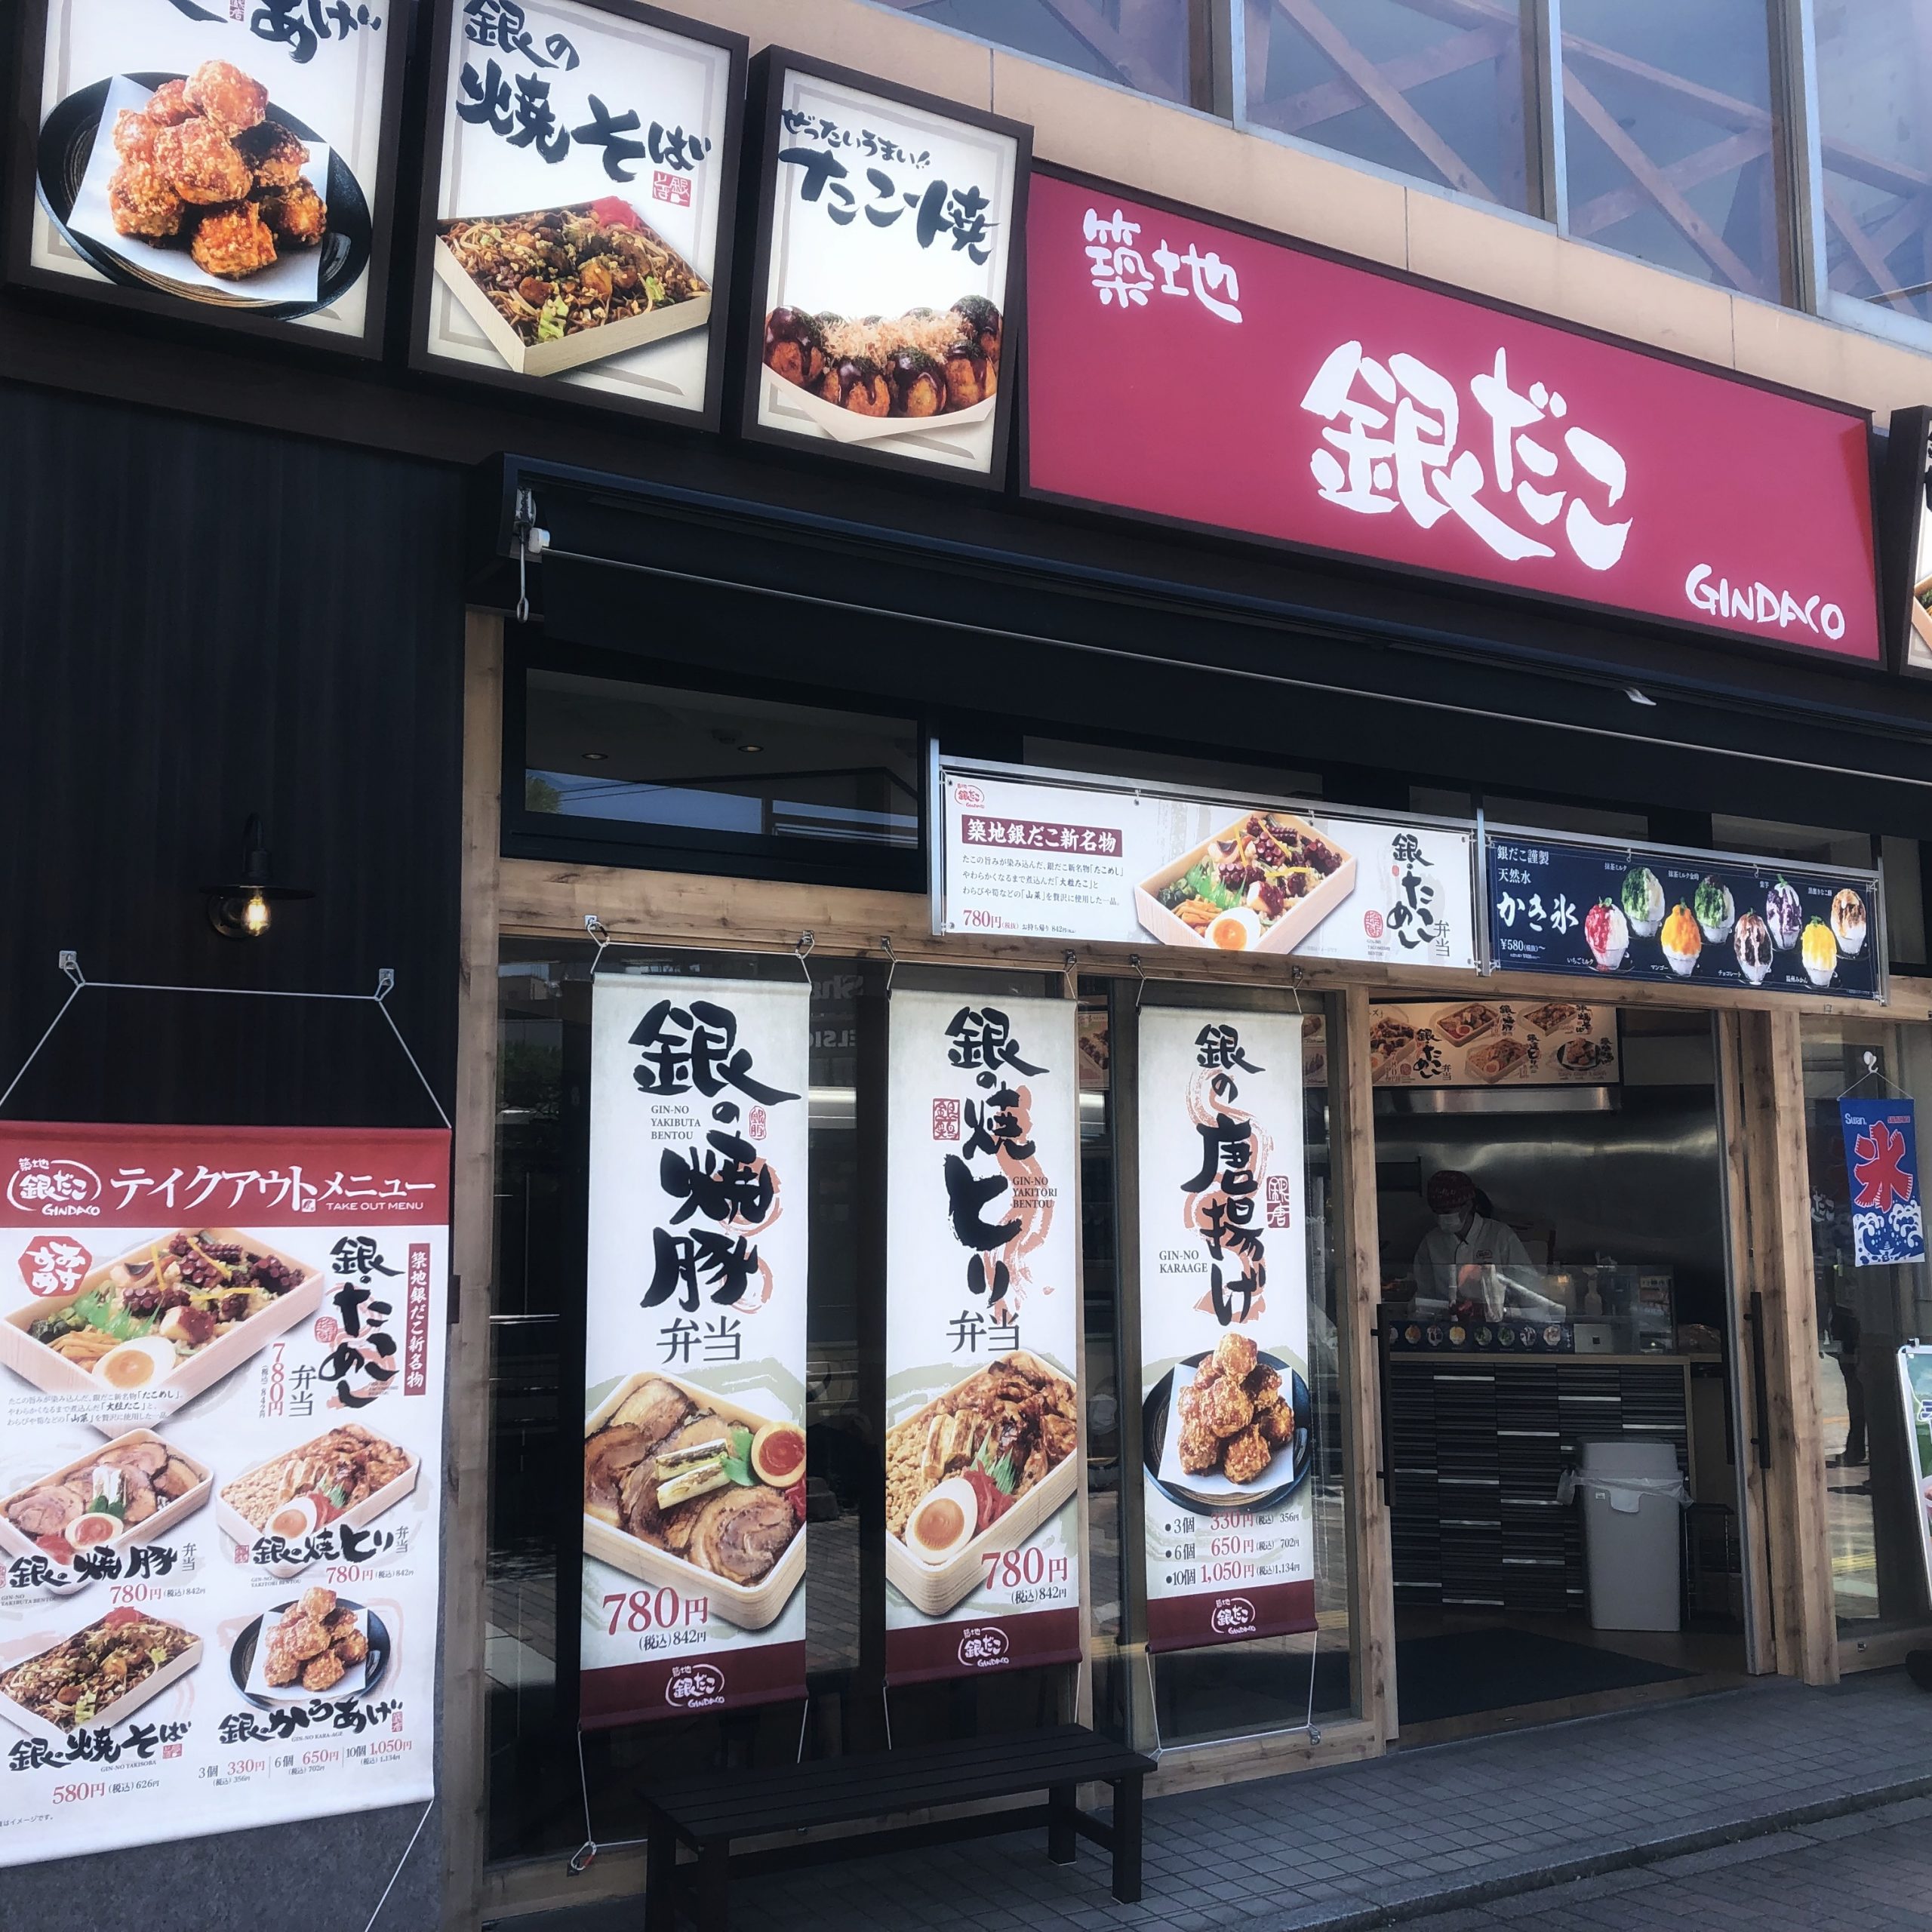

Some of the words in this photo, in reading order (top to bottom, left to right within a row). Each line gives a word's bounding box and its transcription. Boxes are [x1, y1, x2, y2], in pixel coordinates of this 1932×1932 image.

[463, 0, 580, 71] 銀の
[456, 57, 714, 183] 焼そば
[1083, 208, 1243, 323] 築地
[1300, 340, 1633, 571] 銀だこ
[1685, 563, 1845, 640] GINDACO
[967, 818, 1117, 854] 築地銀だこ新名物
[1497, 845, 1549, 865] 銀だこ謹製
[1498, 868, 1531, 884] 天然水
[1497, 891, 1580, 935] かき氷
[1434, 920, 1451, 956] 弁当
[651, 1106, 689, 1115] GIN-NO
[651, 1118, 700, 1128] YAKIBUTA
[651, 1131, 694, 1140] BENTOU
[18, 1158, 49, 1171] 築地
[1180, 1023, 1266, 1326] 銀の唐揚げ
[1854, 1120, 1913, 1214] 氷
[20, 1170, 88, 1201] 銀だこ
[110, 1164, 437, 1211] テイクアウトメニュー
[1013, 1177, 1048, 1186] GIN-NO
[1013, 1187, 1057, 1197] YAKITORI
[42, 1204, 100, 1216] GINDACO
[326, 1201, 358, 1211] TAKE
[360, 1201, 386, 1211] OUT
[388, 1201, 423, 1211] MENU
[1013, 1199, 1053, 1208] BENTOU
[1159, 1250, 1199, 1261] GIN-NO
[1159, 1263, 1208, 1273] KARAAGE
[407, 1251, 428, 1389] 築地銀だこ新名物
[946, 1309, 1020, 1353] 弁当
[657, 1315, 742, 1364] 弁当
[268, 1343, 285, 1417] 780円
[288, 1364, 316, 1417] 弁当
[1210, 1509, 1254, 1531] 330円
[251, 1524, 394, 1564] 銀の焼とり
[395, 1525, 409, 1554] 弁当
[1211, 1535, 1254, 1556] 650円
[8, 1545, 178, 1589] 銀の焼豚
[181, 1542, 197, 1572] 弁当
[981, 1547, 1067, 1590] 780円
[326, 1565, 374, 1585] 780円
[110, 1583, 162, 1604] 780円
[602, 1587, 709, 1635] 780円
[1217, 1604, 1248, 1626] 銀だこ
[964, 1635, 1001, 1658] 銀だこ
[672, 1672, 717, 1698] 銀だこ
[218, 1697, 403, 1745] 銀のからあげ
[8, 1721, 192, 1771] 銀の焼そば
[302, 1749, 340, 1766] 650円
[227, 1758, 265, 1776] 330円
[52, 1782, 106, 1804] 580円
